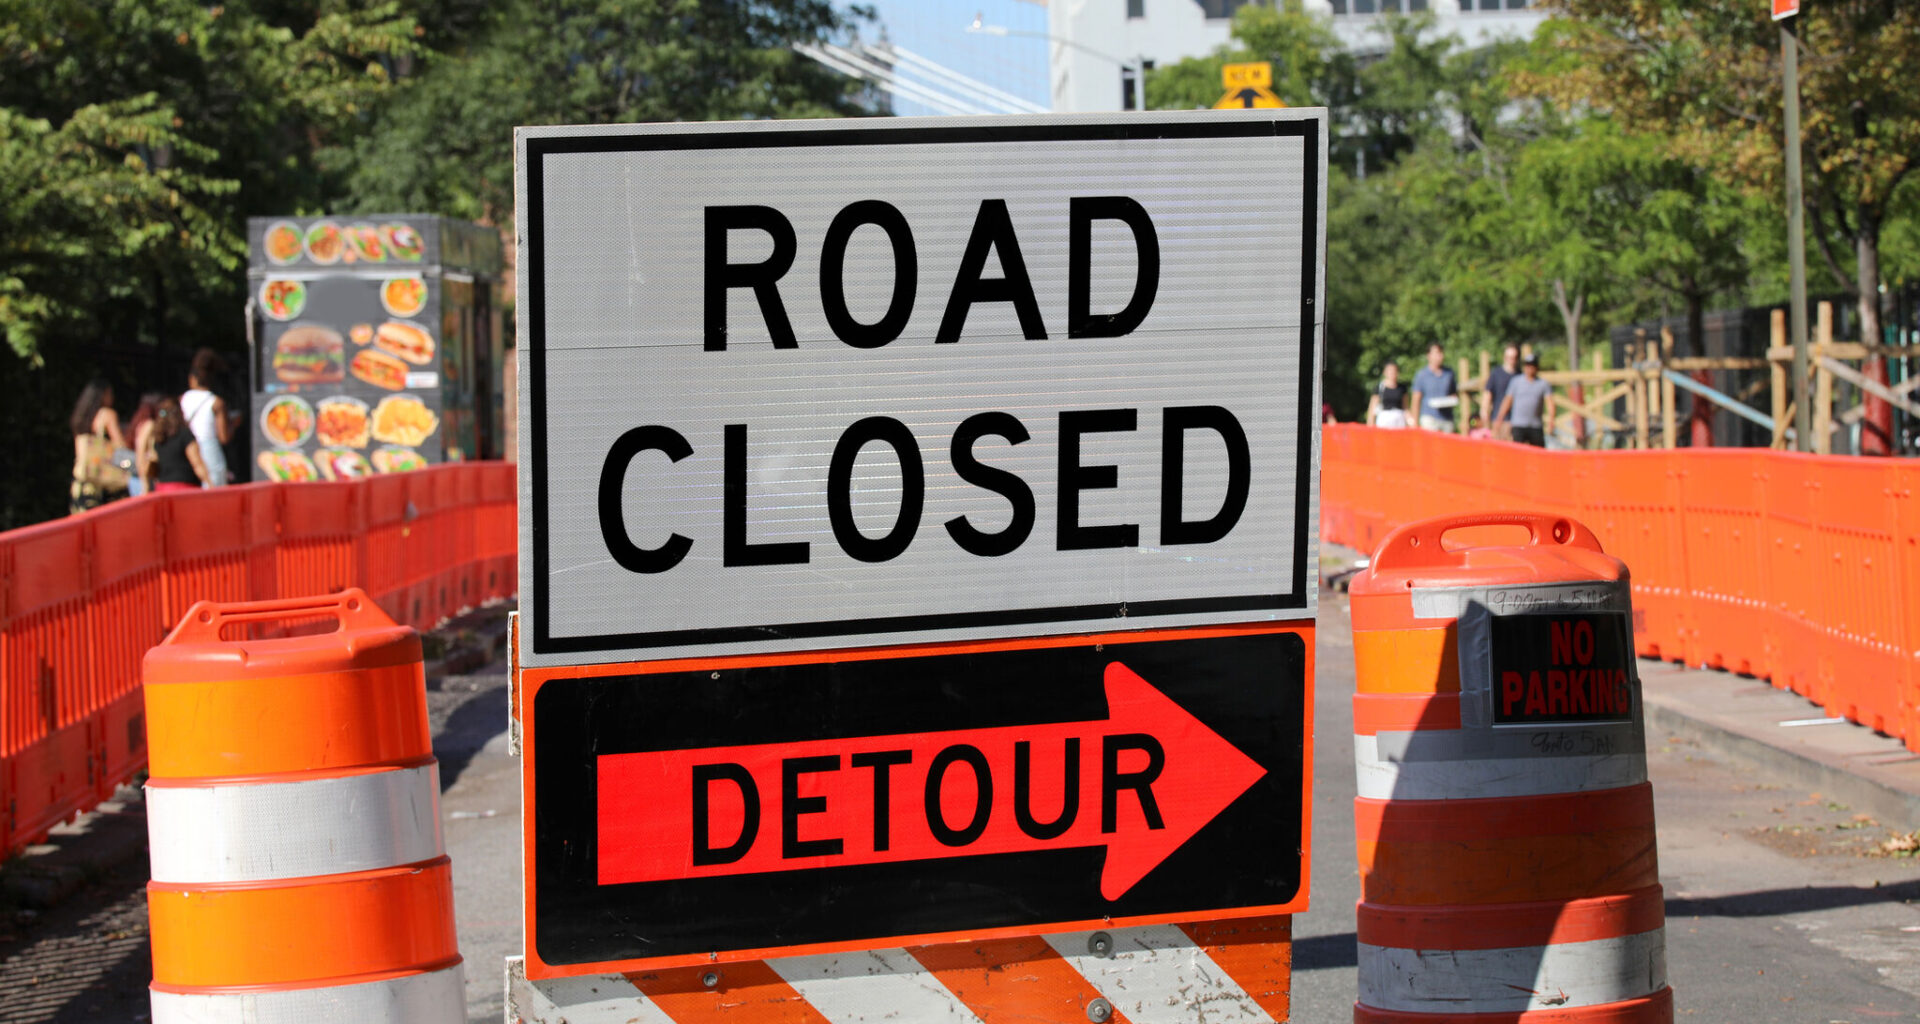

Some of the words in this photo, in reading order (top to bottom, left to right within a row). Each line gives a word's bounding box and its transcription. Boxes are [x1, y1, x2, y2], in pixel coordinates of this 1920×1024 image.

[704, 195, 1160, 351] ROAD
[598, 405, 1251, 574] CLOSED
[1502, 668, 1628, 716] PARKING
[1551, 619, 1595, 666] NO
[692, 733, 1166, 866] DETOUR
